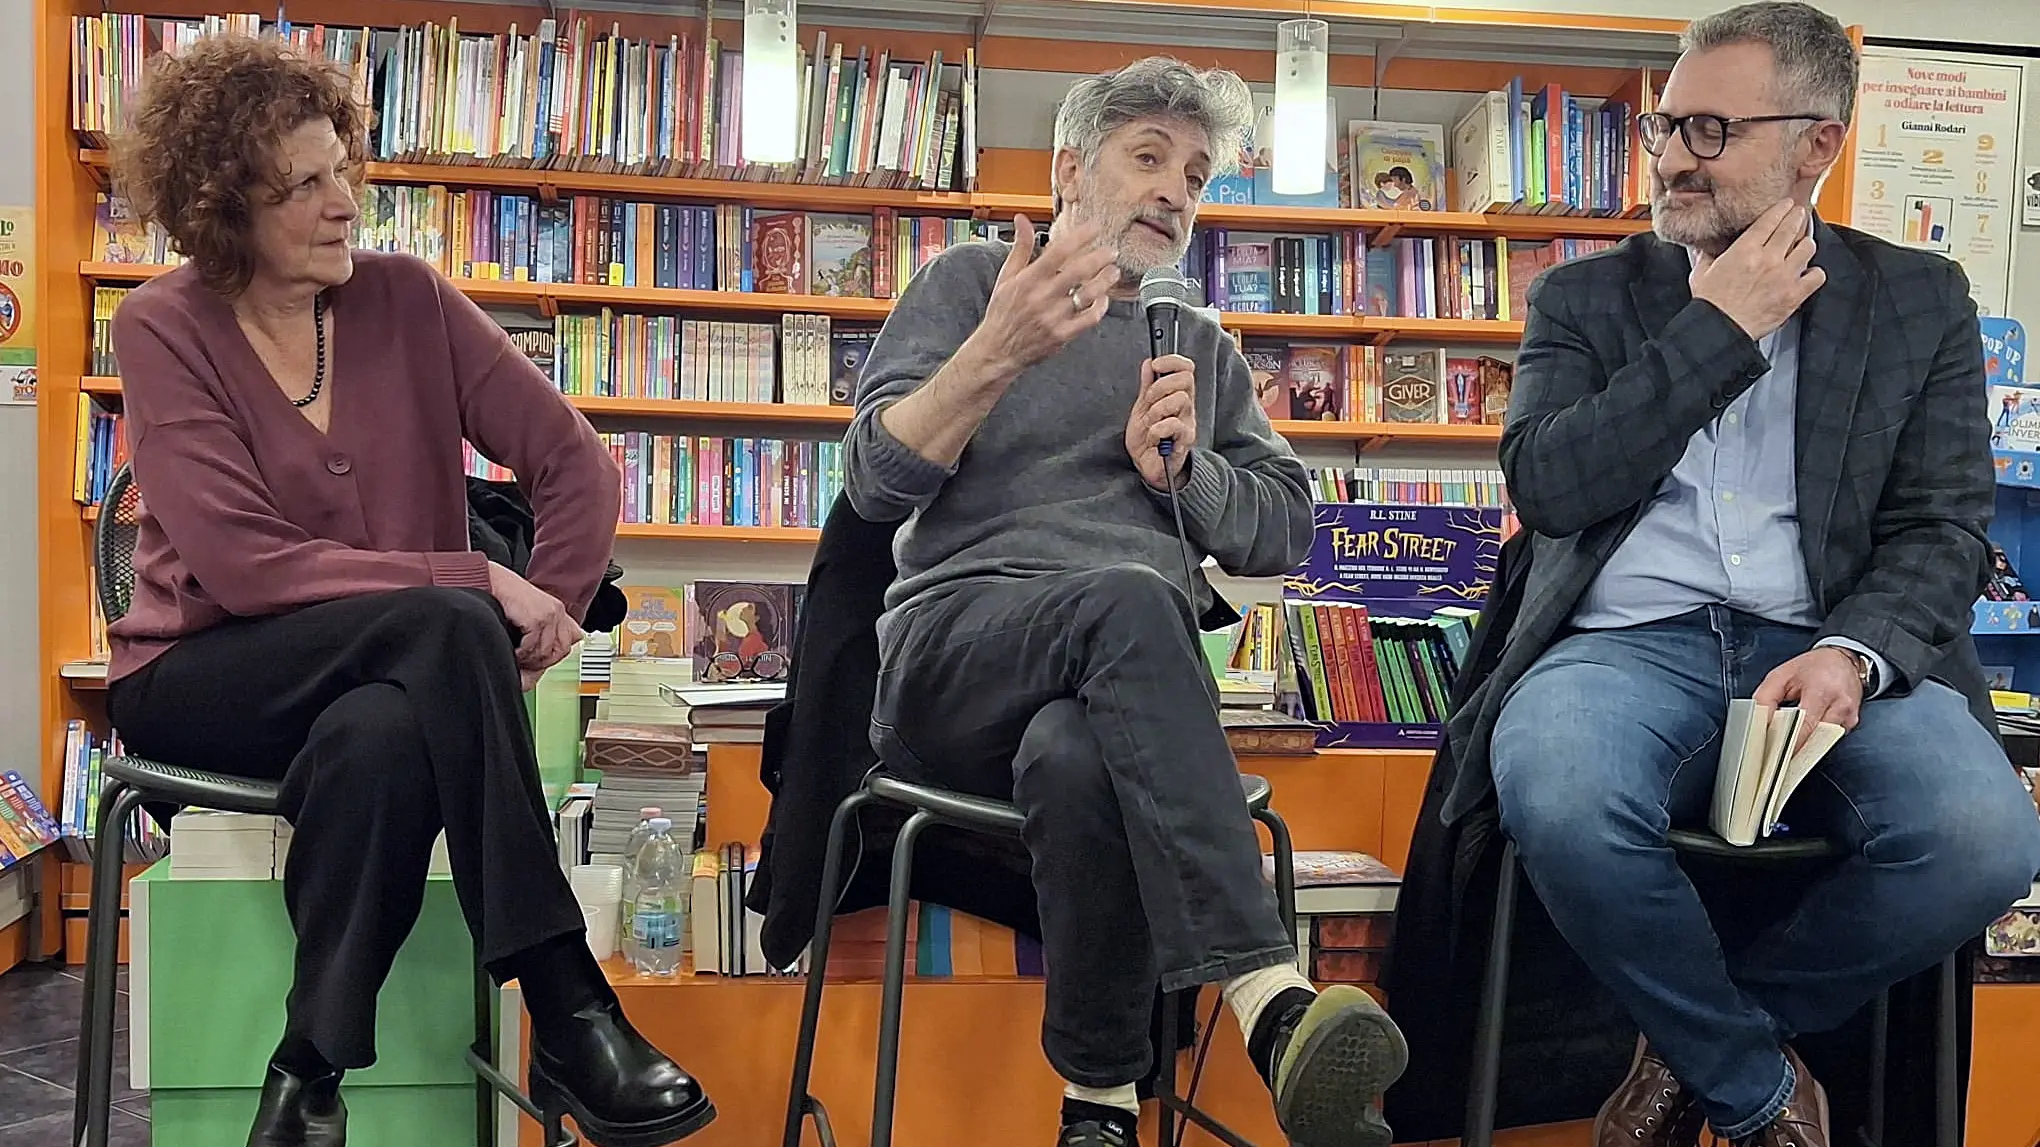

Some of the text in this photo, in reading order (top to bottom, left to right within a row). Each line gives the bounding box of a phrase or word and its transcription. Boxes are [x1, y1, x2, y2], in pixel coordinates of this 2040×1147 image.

[1908, 67, 1967, 83] Nove modi
[1862, 80, 2007, 101] per insegnare ai bambini
[1884, 99, 1984, 114] a odiare la lettura
[1878, 124, 1887, 147] 1
[1901, 120, 1967, 134] Gianni Rodari
[1977, 134, 1995, 150] 9
[1922, 149, 1944, 165] 2
[1870, 180, 1885, 200] 3
[1977, 213, 1990, 234] 7
[1980, 332, 2022, 366] POP UP
[1388, 383, 1430, 400] GIVER
[1369, 509, 1417, 521] R.L. STINE
[1331, 526, 1458, 562] FEAR STREET
